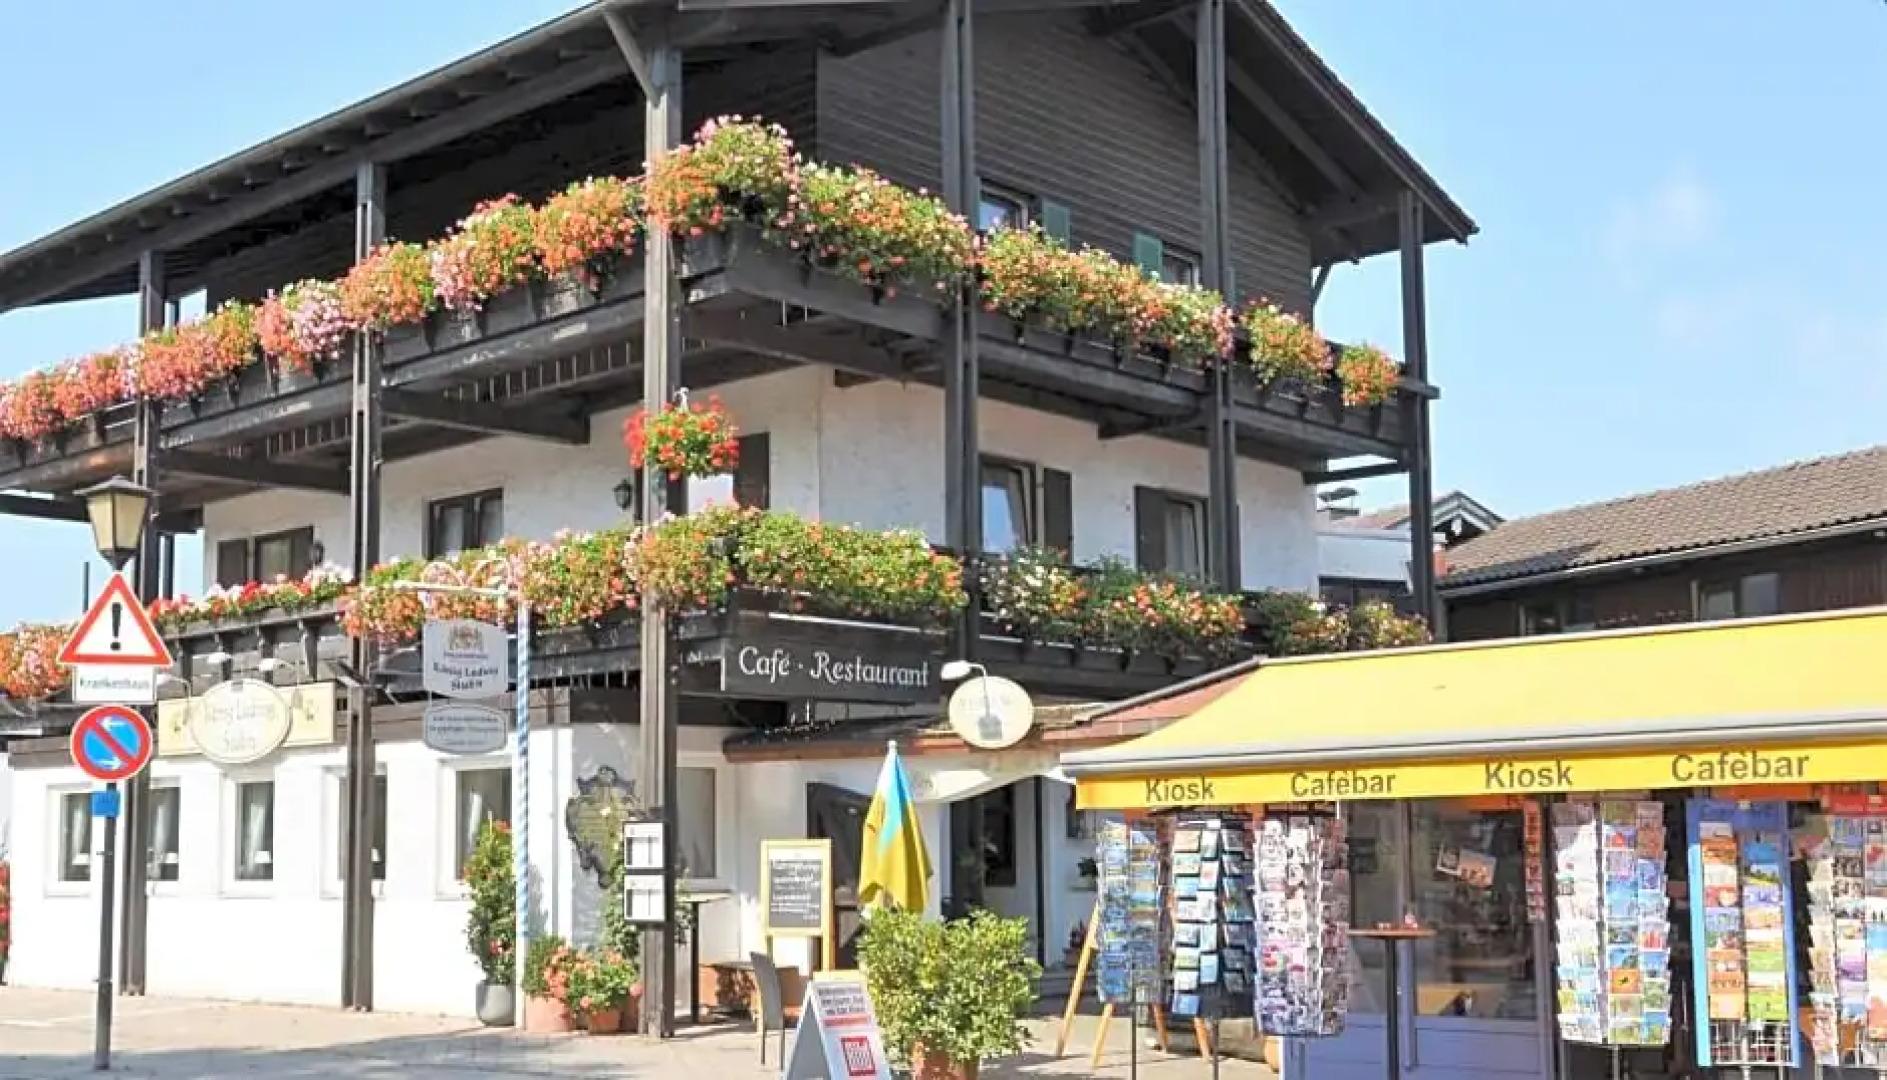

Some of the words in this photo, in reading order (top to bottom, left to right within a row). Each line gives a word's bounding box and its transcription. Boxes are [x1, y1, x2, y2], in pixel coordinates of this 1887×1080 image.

[738, 645, 791, 684] Café
[809, 651, 929, 688] Restaurant
[1145, 775, 1216, 803] Kiosk
[1484, 757, 1574, 790] Kiosk
